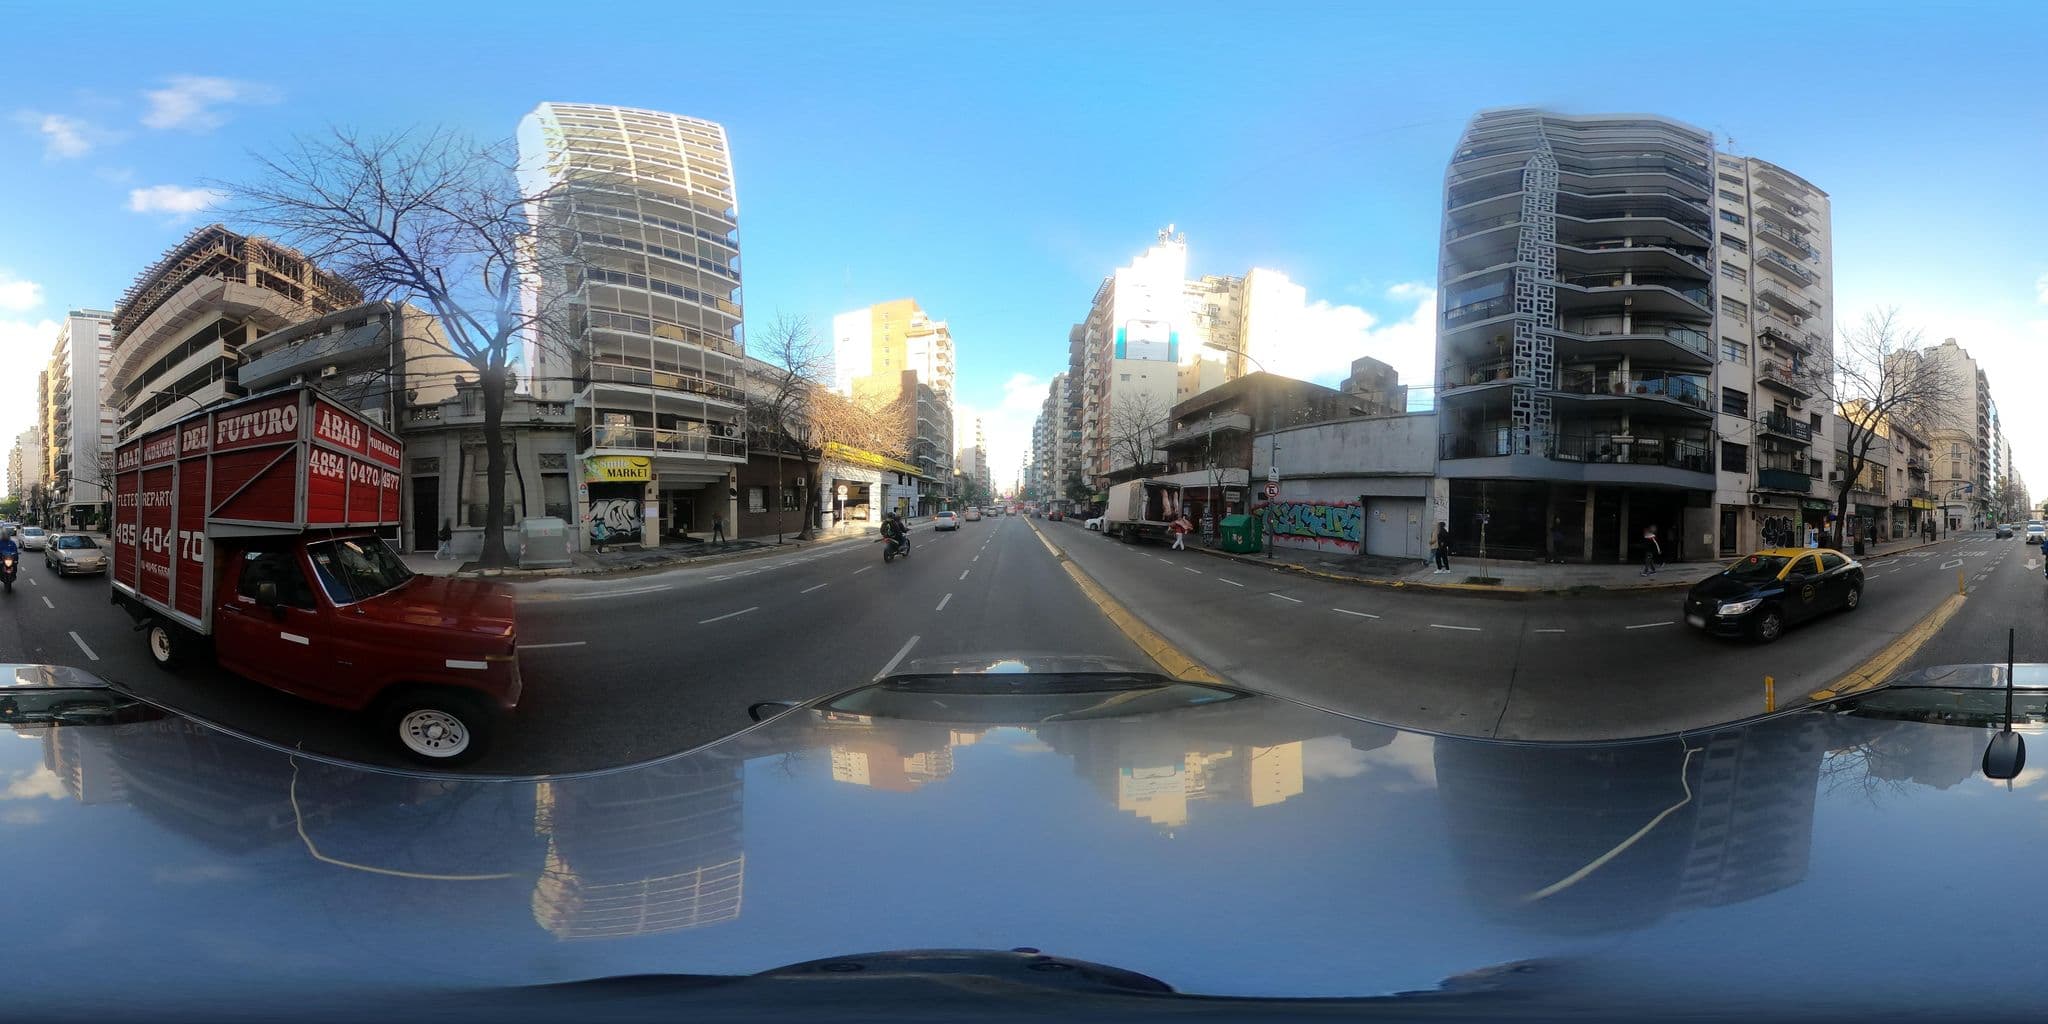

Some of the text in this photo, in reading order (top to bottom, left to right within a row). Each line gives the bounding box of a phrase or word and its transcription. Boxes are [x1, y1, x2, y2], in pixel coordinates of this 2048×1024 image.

[182, 425, 208, 452] DEL
[217, 404, 298, 444] FUTURO
[319, 410, 400, 459] ABAD MUDANZAS
[309, 449, 345, 479] 4854
[608, 469, 647, 477] MARKET
[117, 492, 138, 507] FLETES
